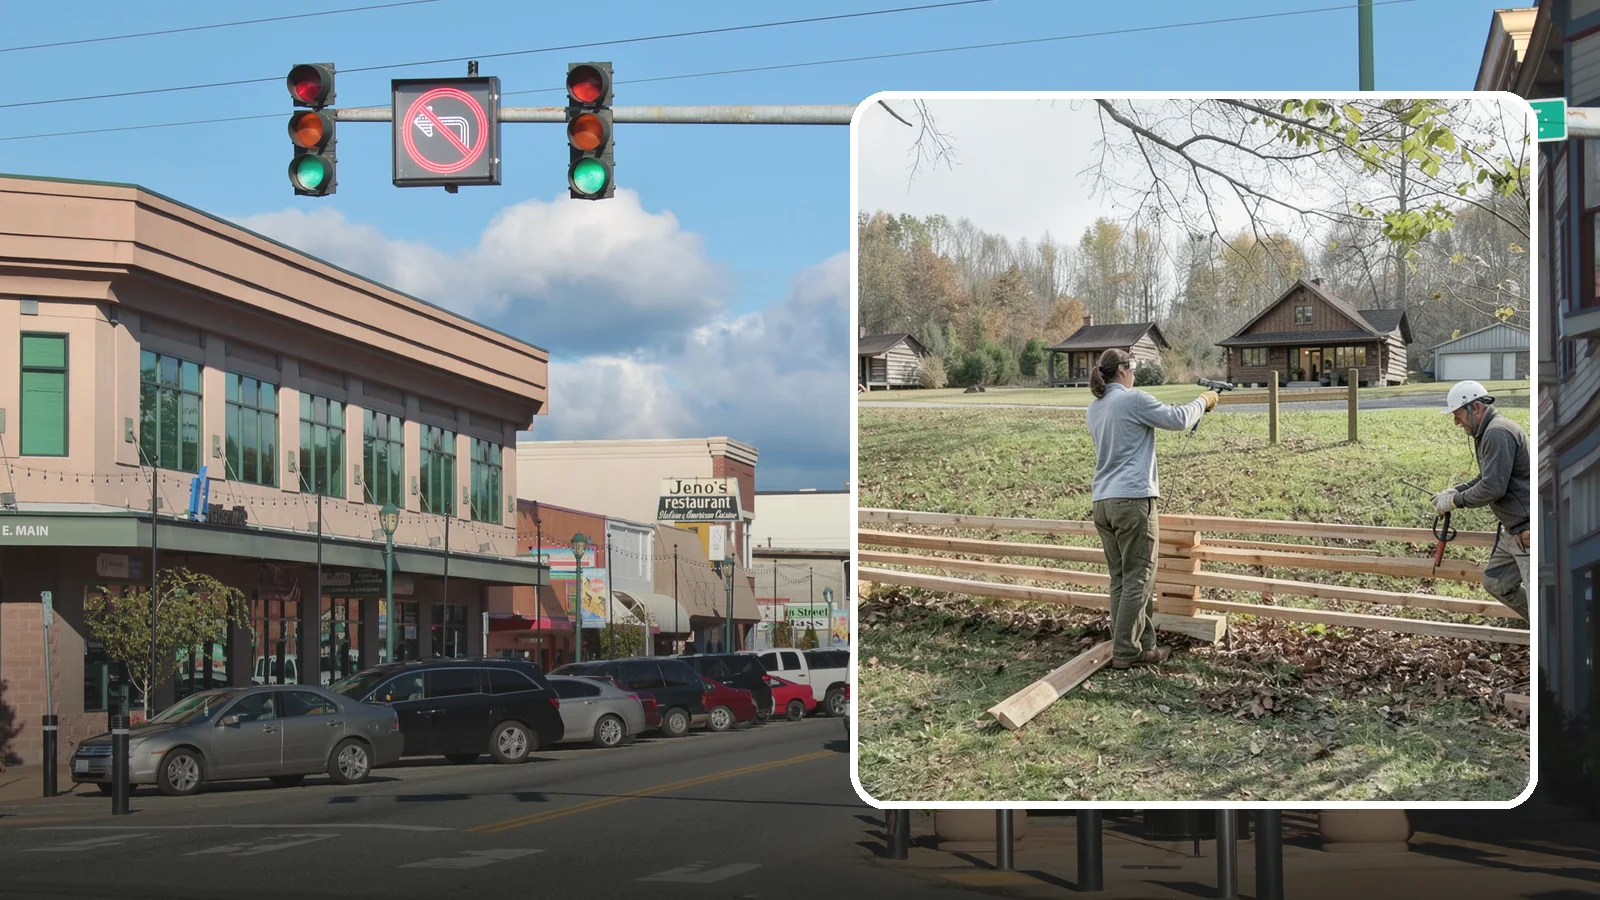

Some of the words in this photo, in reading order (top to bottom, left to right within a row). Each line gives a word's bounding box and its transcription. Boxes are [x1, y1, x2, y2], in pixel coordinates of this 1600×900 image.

[670, 480, 727, 494] Jeno's
[665, 497, 731, 508] restaurant
[686, 509, 714, 519] American
[715, 509, 737, 519] Cuisine
[2, 525, 13, 536] E.
[15, 525, 49, 536] MAIN
[797, 607, 828, 617] Street
[791, 619, 823, 627] lass
